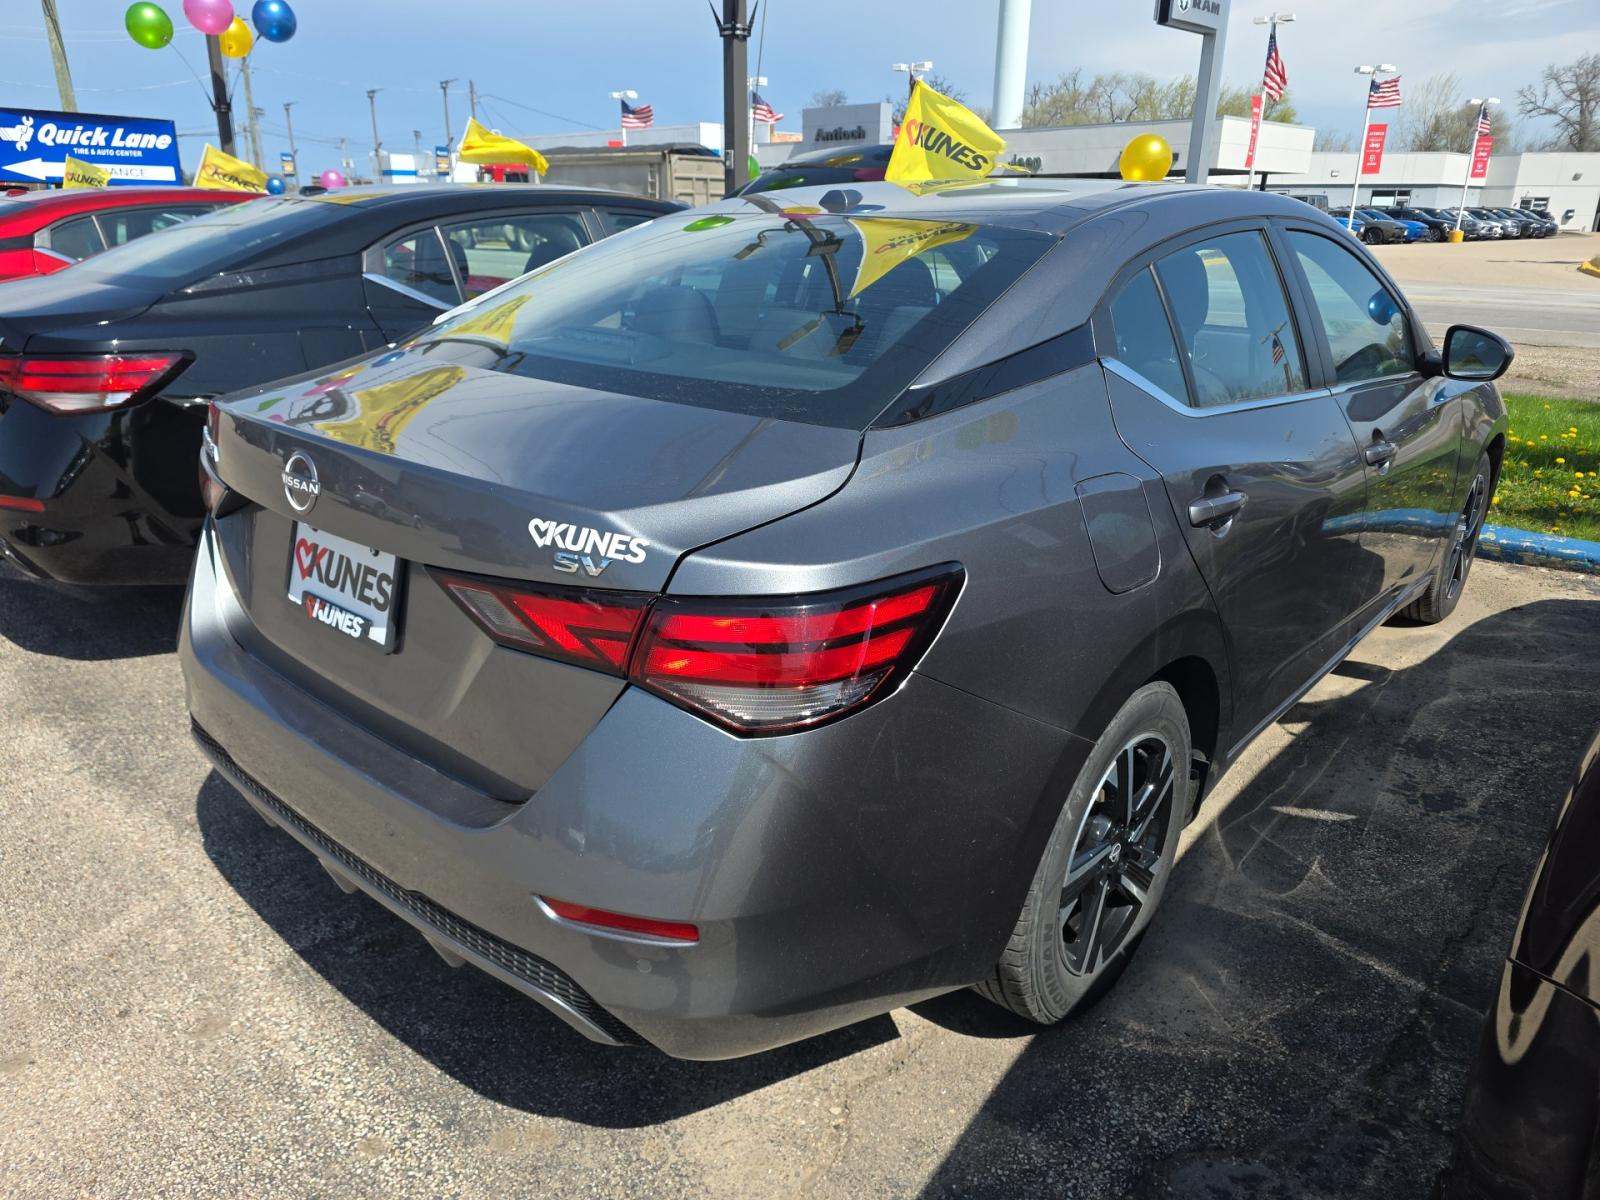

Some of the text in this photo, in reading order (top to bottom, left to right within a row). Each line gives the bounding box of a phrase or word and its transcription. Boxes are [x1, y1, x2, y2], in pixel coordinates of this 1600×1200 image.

[1192, 0, 1220, 15] RAM
[37, 123, 172, 149] Quick Lane
[914, 122, 989, 170] KUNES
[282, 473, 320, 494] NISSAN
[544, 520, 650, 564] KUNES
[309, 542, 393, 612] KUNES
[553, 551, 614, 577] SV
[312, 598, 364, 638] KUNES
